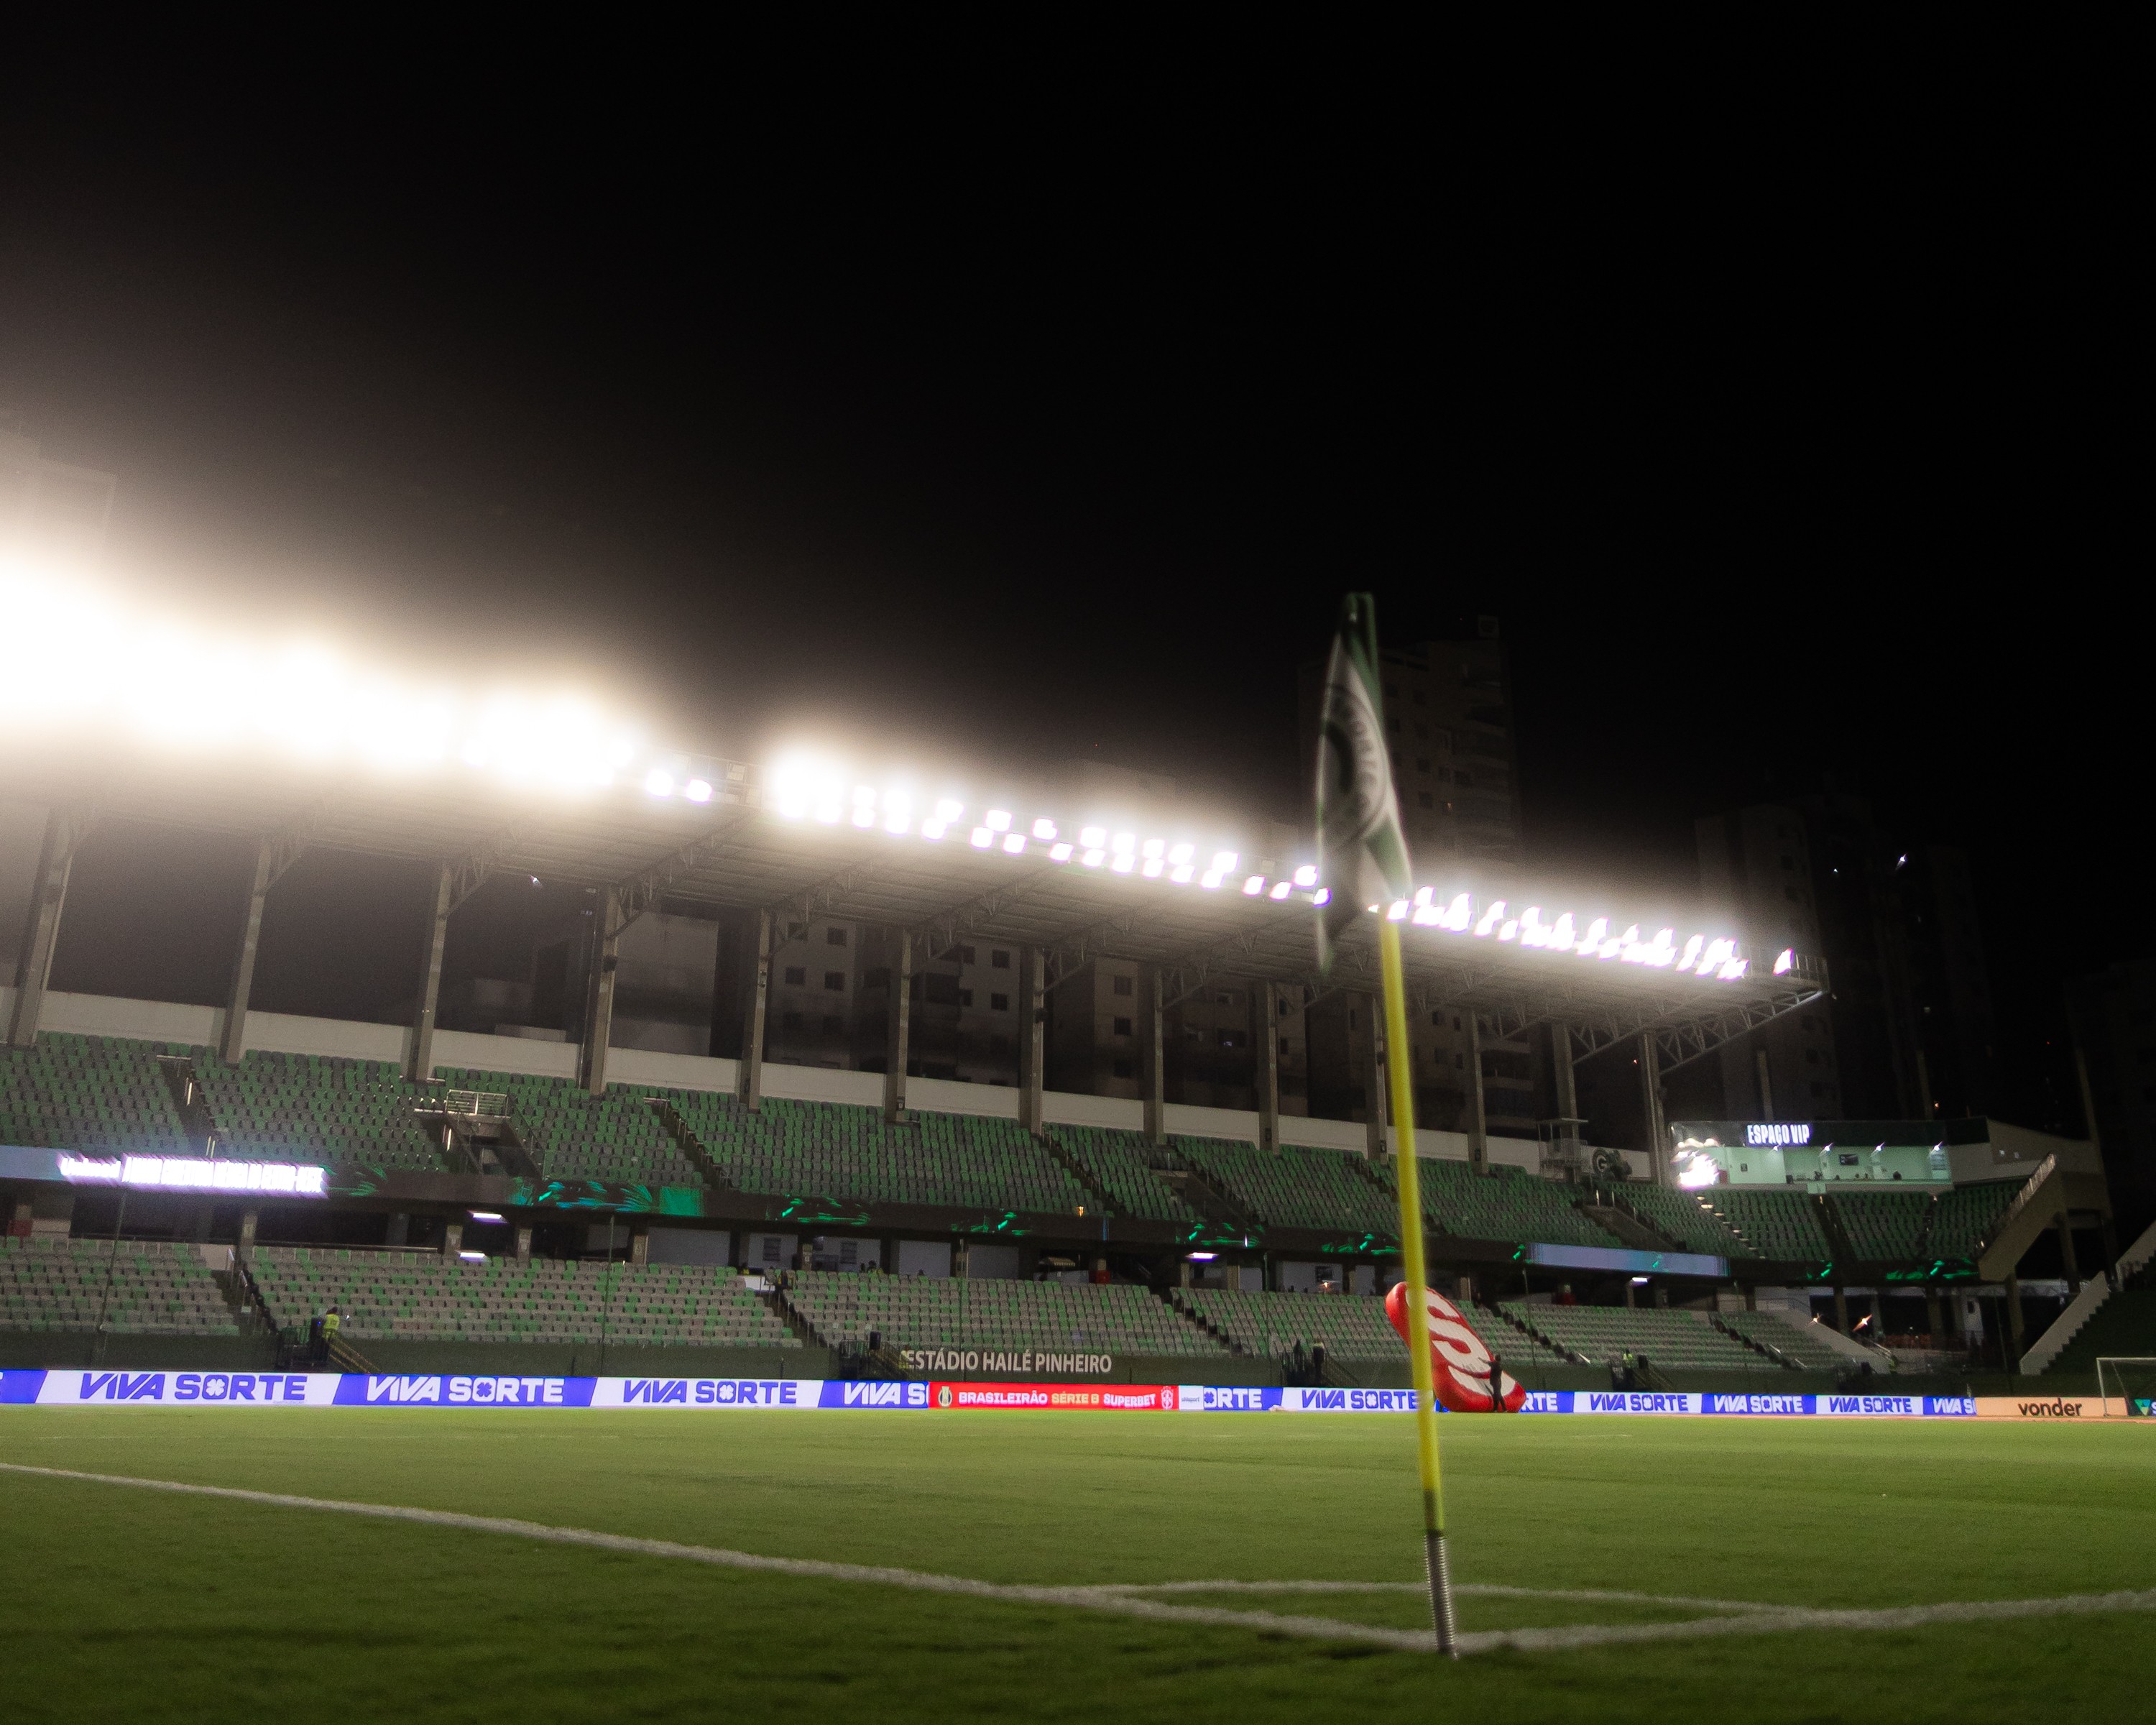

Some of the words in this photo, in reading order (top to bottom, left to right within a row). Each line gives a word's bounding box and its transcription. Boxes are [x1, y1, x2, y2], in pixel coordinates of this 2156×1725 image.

[1747, 1124, 1790, 1145] ESPAÇO
[1790, 1124, 1810, 1144] VIP
[908, 1347, 979, 1371] ESTÁDIO
[983, 1348, 1032, 1372] HAILÉ
[1036, 1353, 1112, 1374] PINHEIRO
[80, 1373, 165, 1399] VIVA
[175, 1374, 307, 1400] SORTE
[367, 1376, 441, 1402] VIVA
[449, 1377, 564, 1403] SORTE
[624, 1380, 686, 1403] VIVA
[696, 1381, 797, 1404] SORTE
[844, 1382, 901, 1404] VIVA
[908, 1383, 929, 1405] S
[959, 1391, 1048, 1404] BRASILEIRÃO
[1052, 1392, 1088, 1404] SÉRIE
[1091, 1394, 1100, 1404] B
[1103, 1393, 1156, 1407] SUPERBET
[1302, 1389, 1345, 1409] VIVA
[1351, 1391, 1418, 1409] SORTE
[1590, 1394, 1626, 1411] VIVA
[1631, 1395, 1688, 1412] SORTE
[1714, 1395, 1749, 1412] VIVA
[1751, 1397, 1802, 1413] SORTE
[1829, 1397, 1859, 1412] VIVA
[1863, 1397, 1912, 1413] SORTE
[1932, 1398, 1962, 1414] VIVA
[1963, 1399, 1976, 1414] S
[2018, 1397, 2082, 1416] vonder
